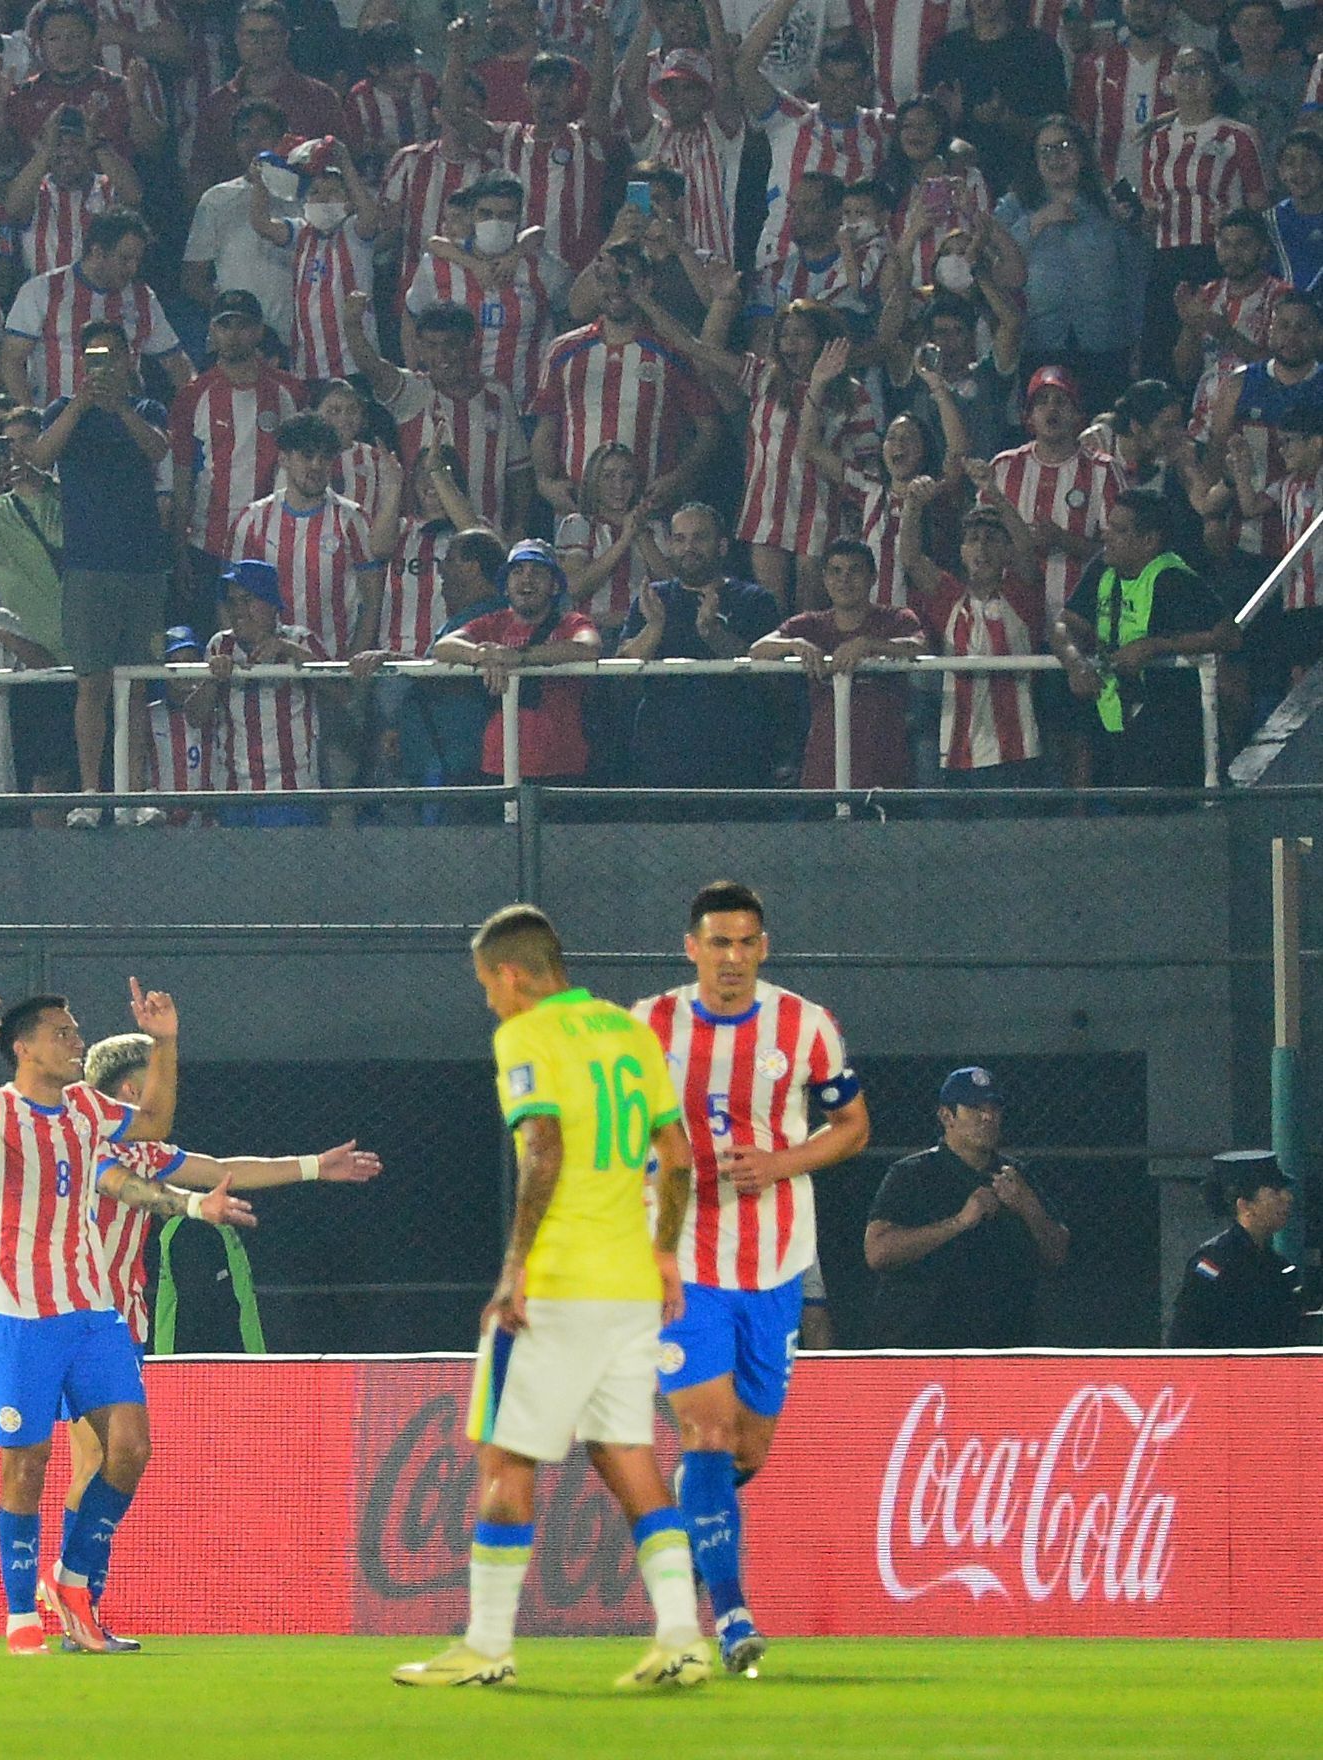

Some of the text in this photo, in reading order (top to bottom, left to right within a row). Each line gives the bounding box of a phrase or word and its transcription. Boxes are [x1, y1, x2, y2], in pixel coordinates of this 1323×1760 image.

[480, 303, 506, 329] 10
[187, 745, 201, 769] 9
[589, 1055, 650, 1172] 16
[707, 1092, 734, 1137] 5
[56, 1159, 72, 1198] 8
